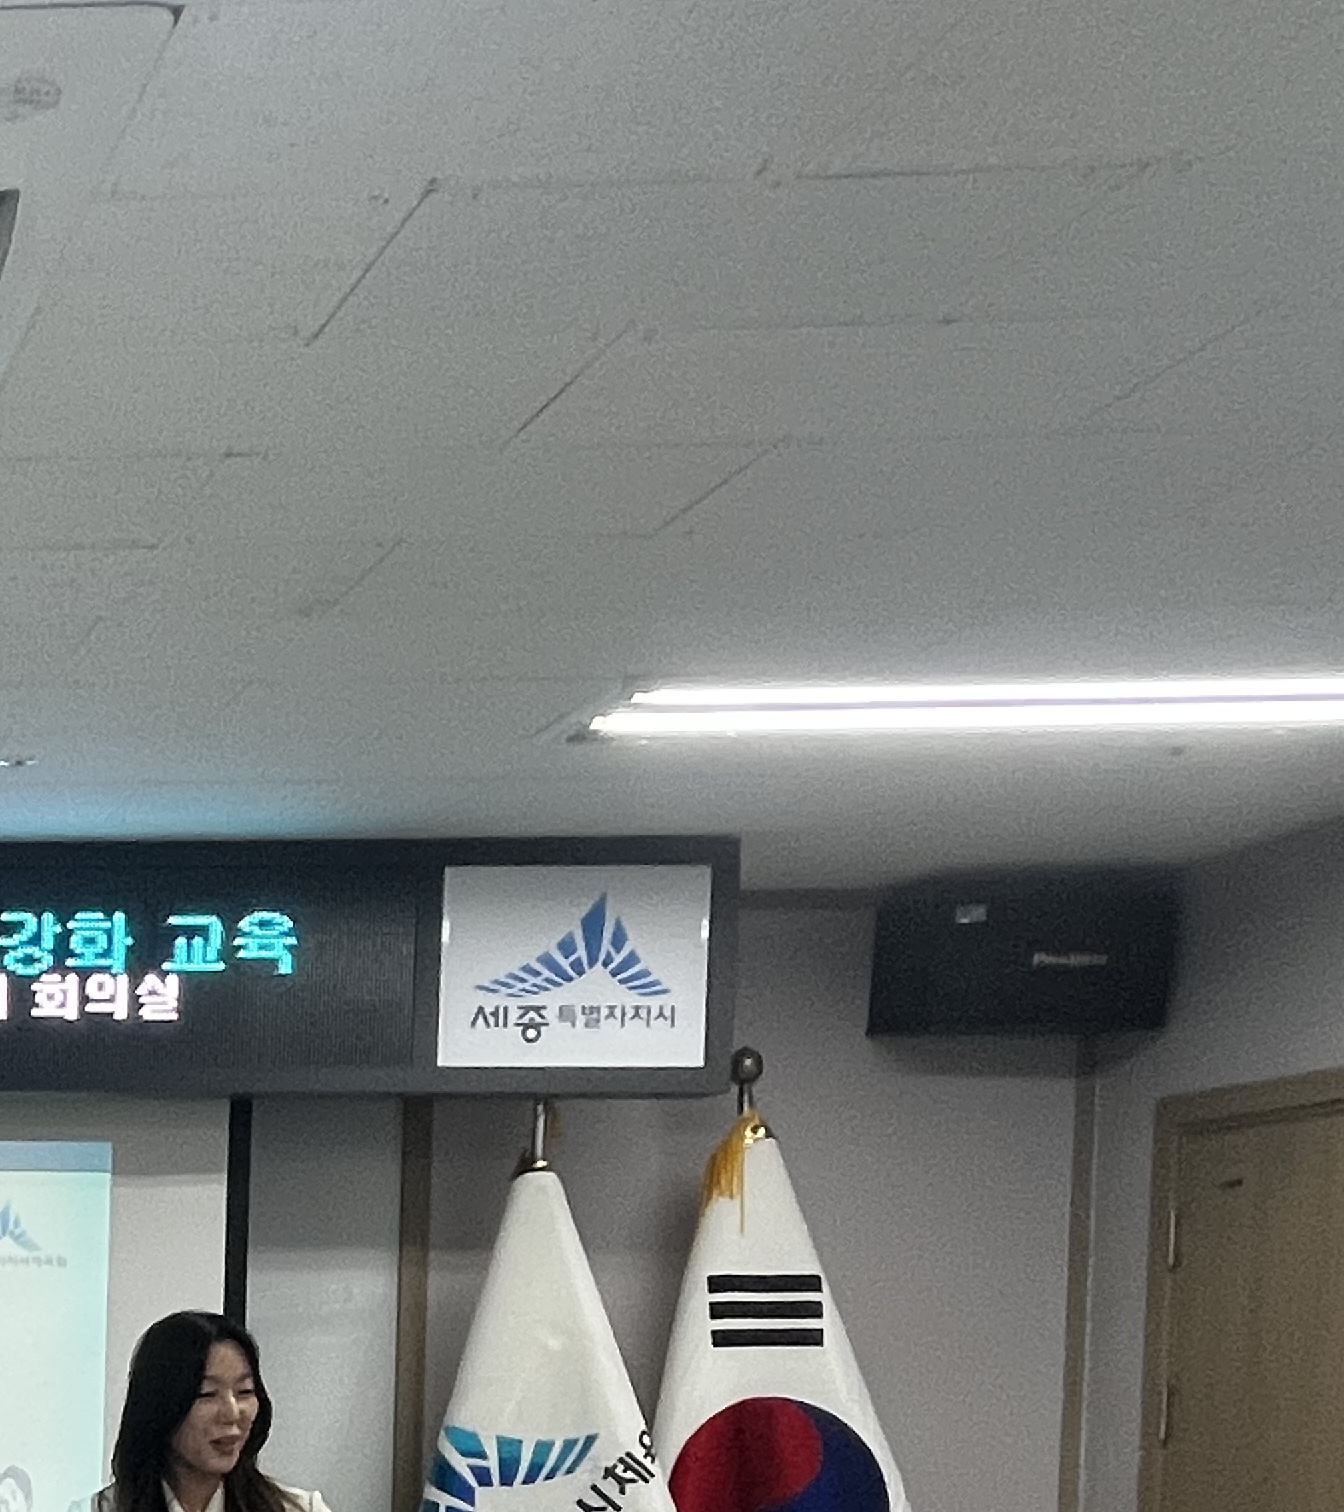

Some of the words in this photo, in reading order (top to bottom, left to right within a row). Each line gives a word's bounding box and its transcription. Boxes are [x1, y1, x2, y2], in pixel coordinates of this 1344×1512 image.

[160, 911, 299, 975] 교육
[28, 972, 182, 1022] 회의실
[469, 1004, 551, 1044] 세종
